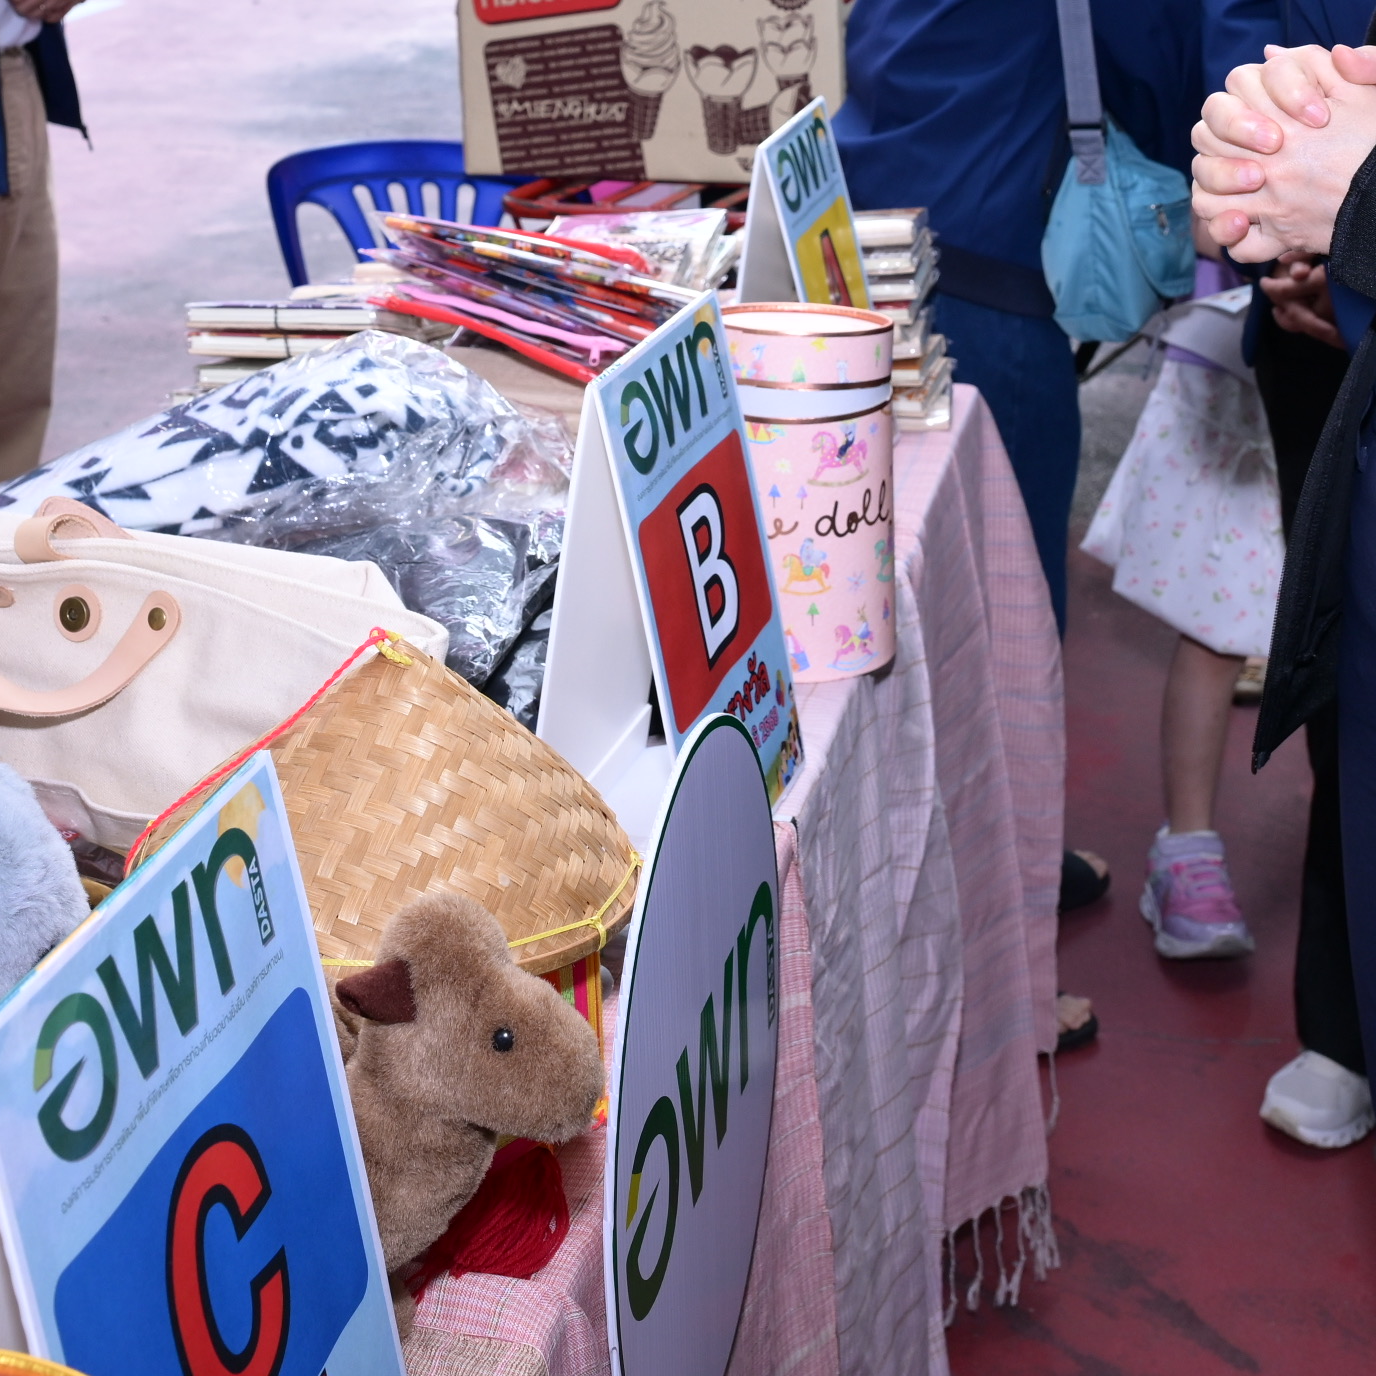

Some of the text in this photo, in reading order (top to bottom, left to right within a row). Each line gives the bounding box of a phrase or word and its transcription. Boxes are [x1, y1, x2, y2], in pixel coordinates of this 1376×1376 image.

[677, 483, 739, 670] B
[248, 855, 273, 943] DASTA
[166, 1123, 291, 1376] C
